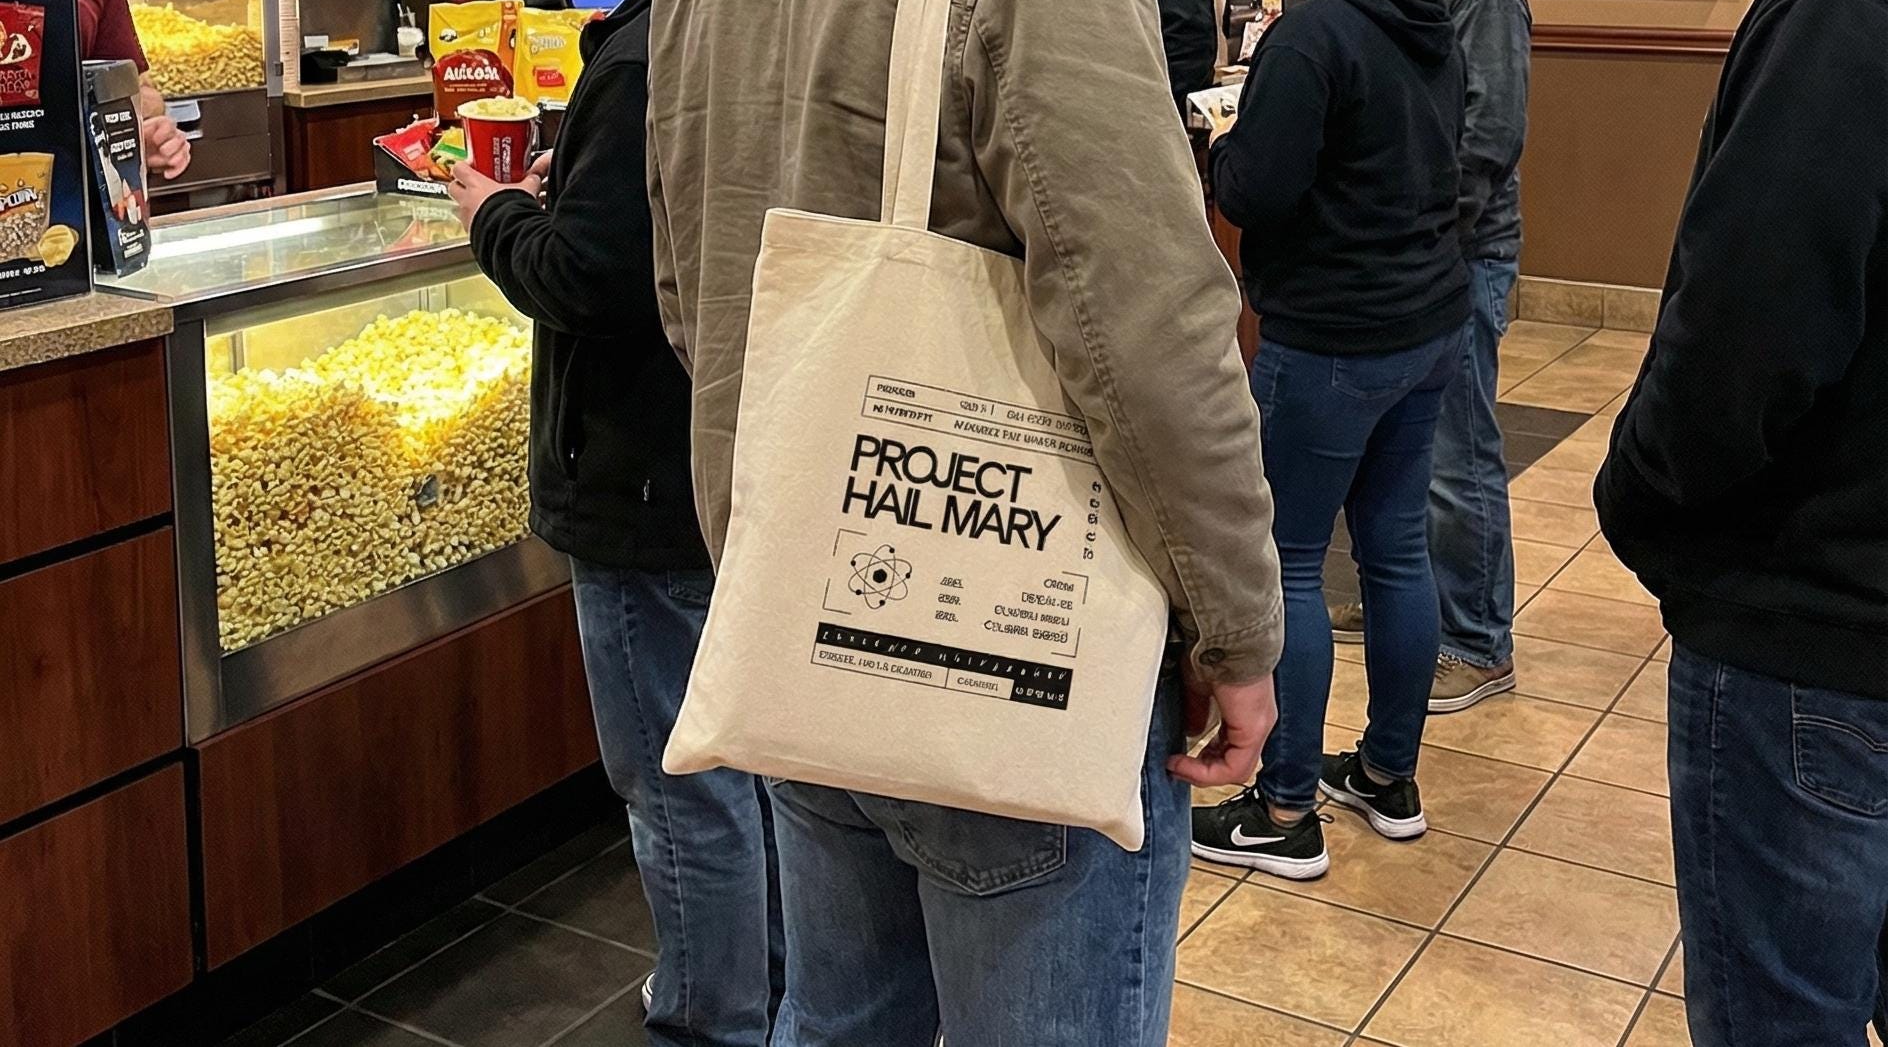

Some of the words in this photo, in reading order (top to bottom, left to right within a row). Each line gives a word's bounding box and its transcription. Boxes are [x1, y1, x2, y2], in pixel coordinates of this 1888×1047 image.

[850, 433, 1033, 503] PROJECT
[842, 475, 933, 530] HAIL
[941, 495, 1063, 552] MARY
